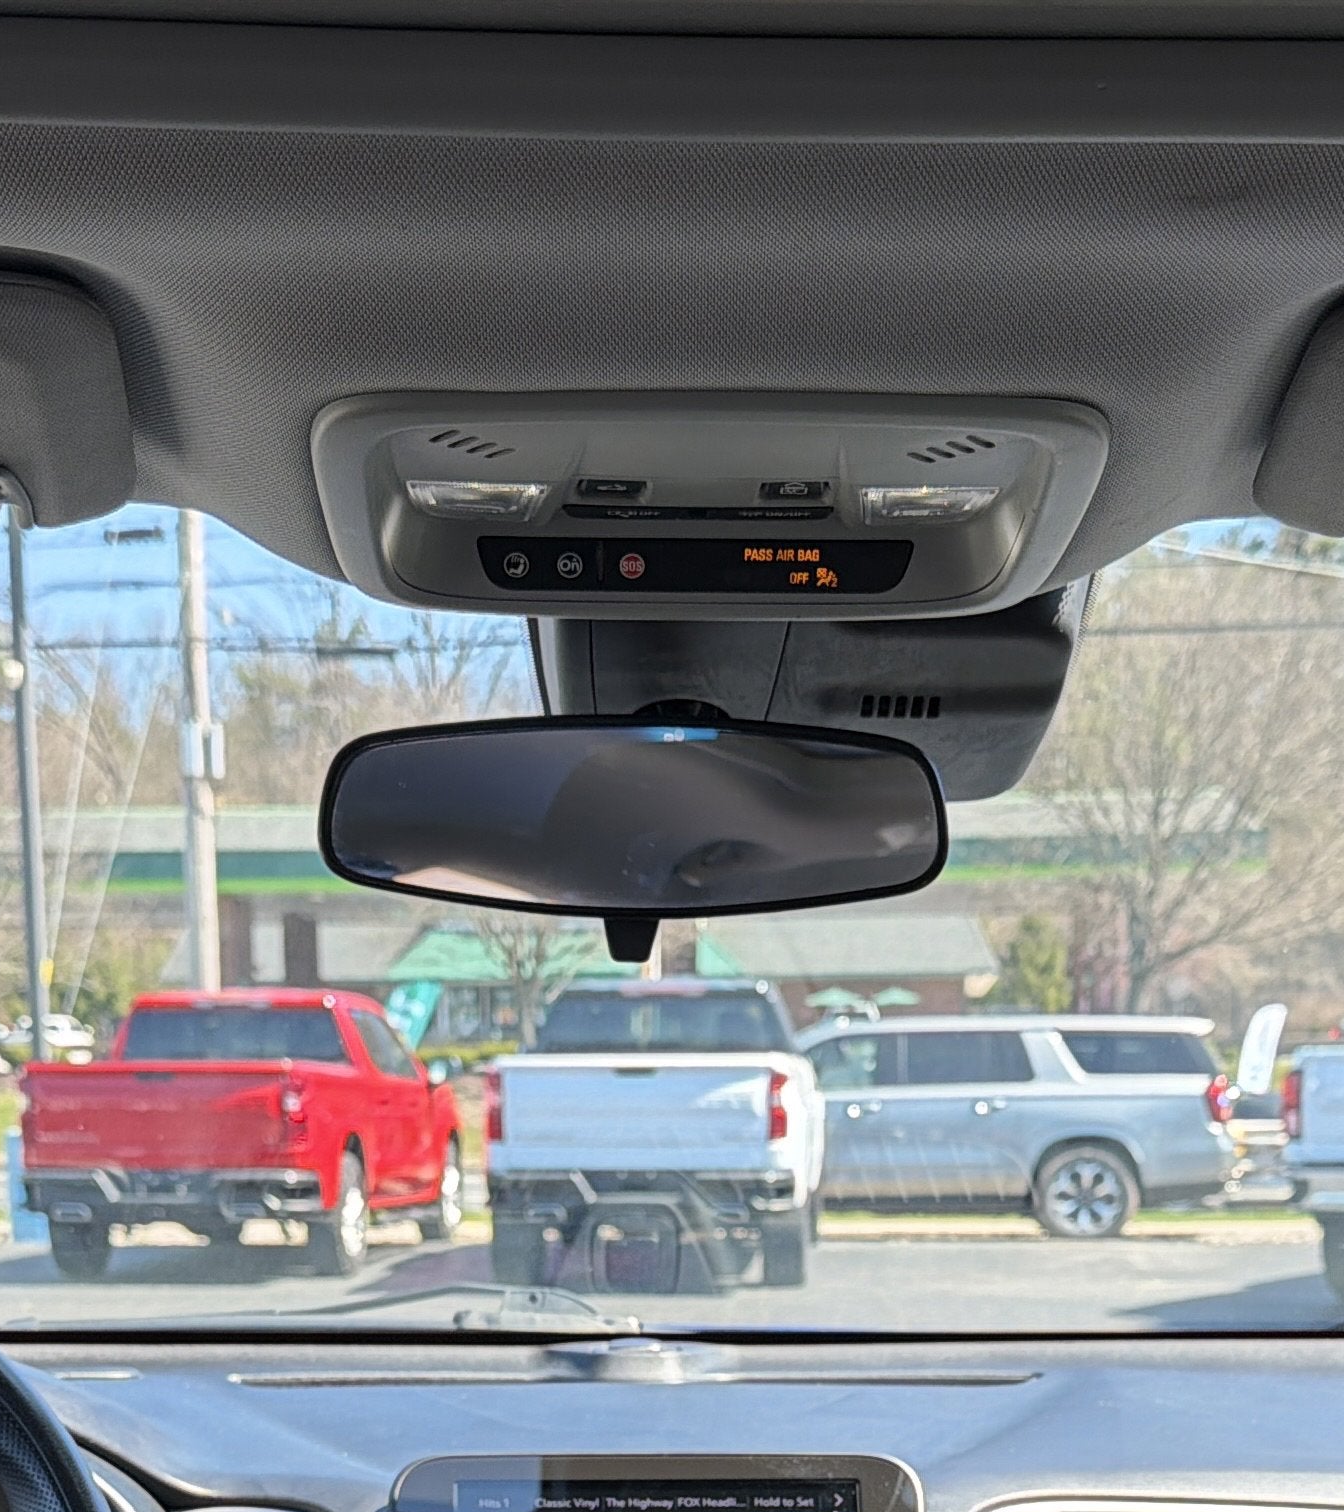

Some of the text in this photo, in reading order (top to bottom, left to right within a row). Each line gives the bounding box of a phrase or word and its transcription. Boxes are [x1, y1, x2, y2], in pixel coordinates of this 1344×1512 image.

[744, 548, 820, 561] PASS AIR BAG
[622, 560, 642, 572] SOS
[789, 572, 810, 584] OFF
[534, 1497, 600, 1511] Classic Vinyl
[605, 1497, 674, 1511] The Highway
[677, 1496, 700, 1508] FOX
[753, 1496, 815, 1507] Hold to Set
